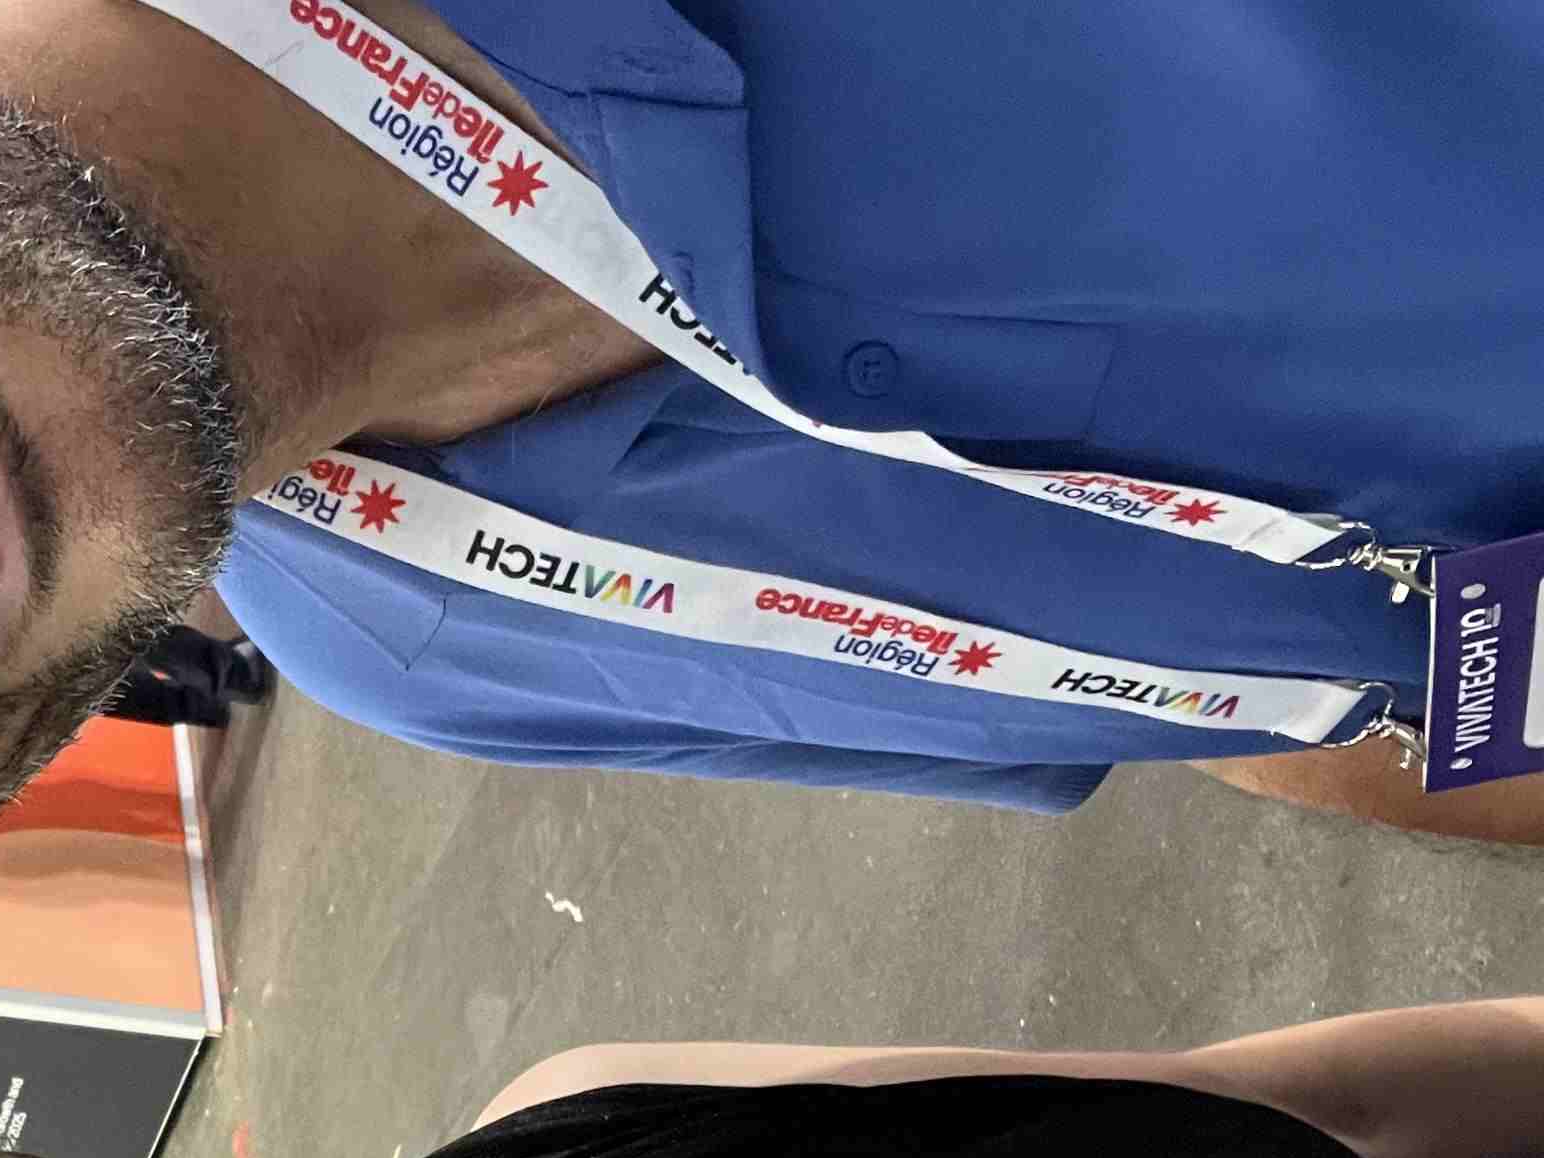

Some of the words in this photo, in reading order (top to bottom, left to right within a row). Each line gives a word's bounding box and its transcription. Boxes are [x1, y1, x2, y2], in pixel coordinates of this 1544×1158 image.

[368, 97, 480, 197] Région
[267, 476, 342, 524] Régi
[1041, 482, 1157, 518] Région
[465, 529, 675, 613] VIVATECH
[833, 634, 940, 677] Région
[1053, 667, 1242, 719] VIVATECH
[1454, 636, 1499, 752] VIVATECH
